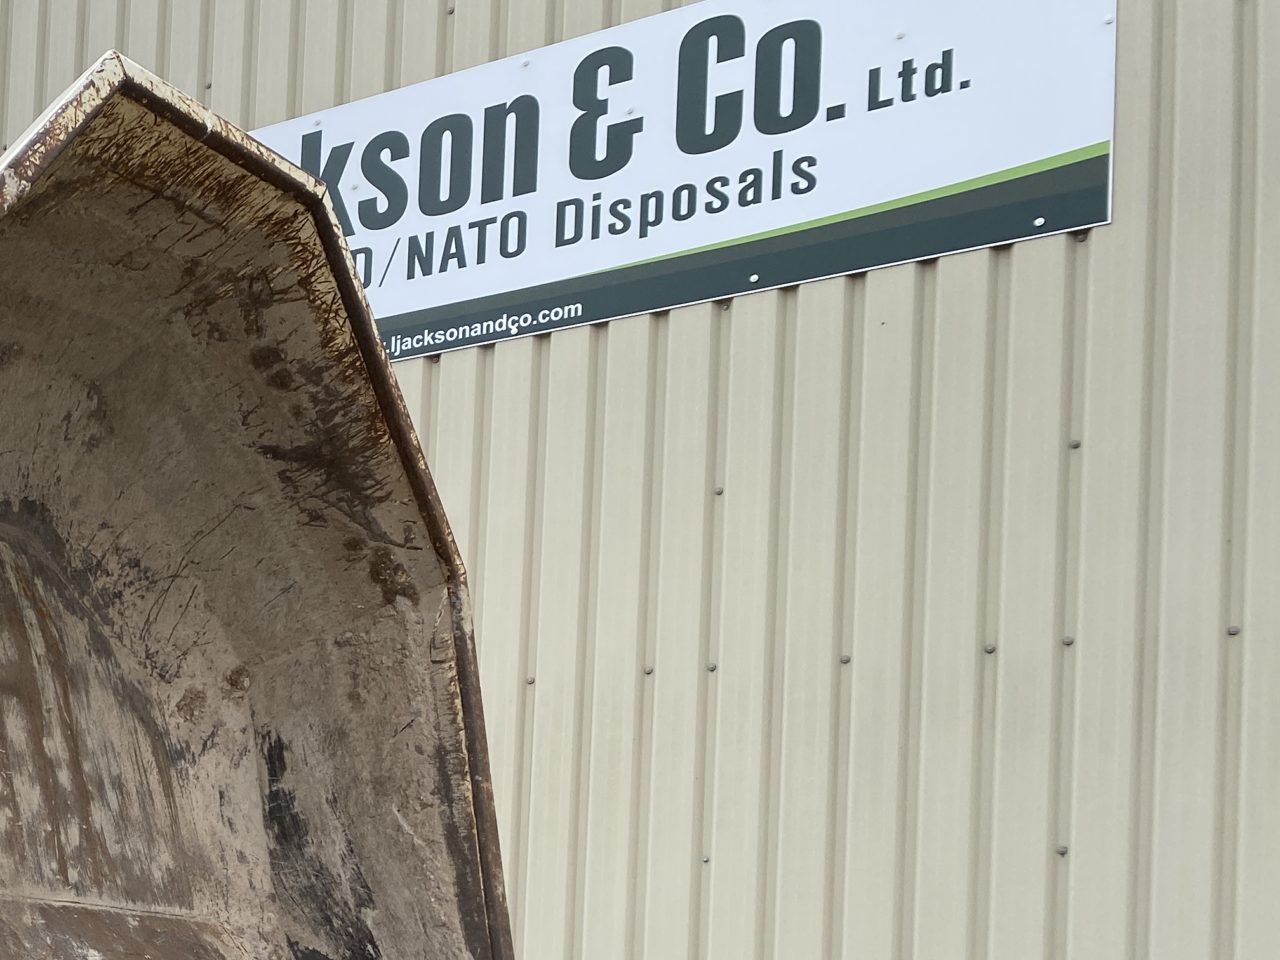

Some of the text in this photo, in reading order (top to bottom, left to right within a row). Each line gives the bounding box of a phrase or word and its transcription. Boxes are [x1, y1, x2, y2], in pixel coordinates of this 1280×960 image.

[569, 46, 644, 181] &
[675, 14, 846, 155] Co.
[867, 48, 971, 112] Ltd.
[555, 149, 818, 249] Disposals
[384, 303, 583, 356] .ljacksonandco.com
